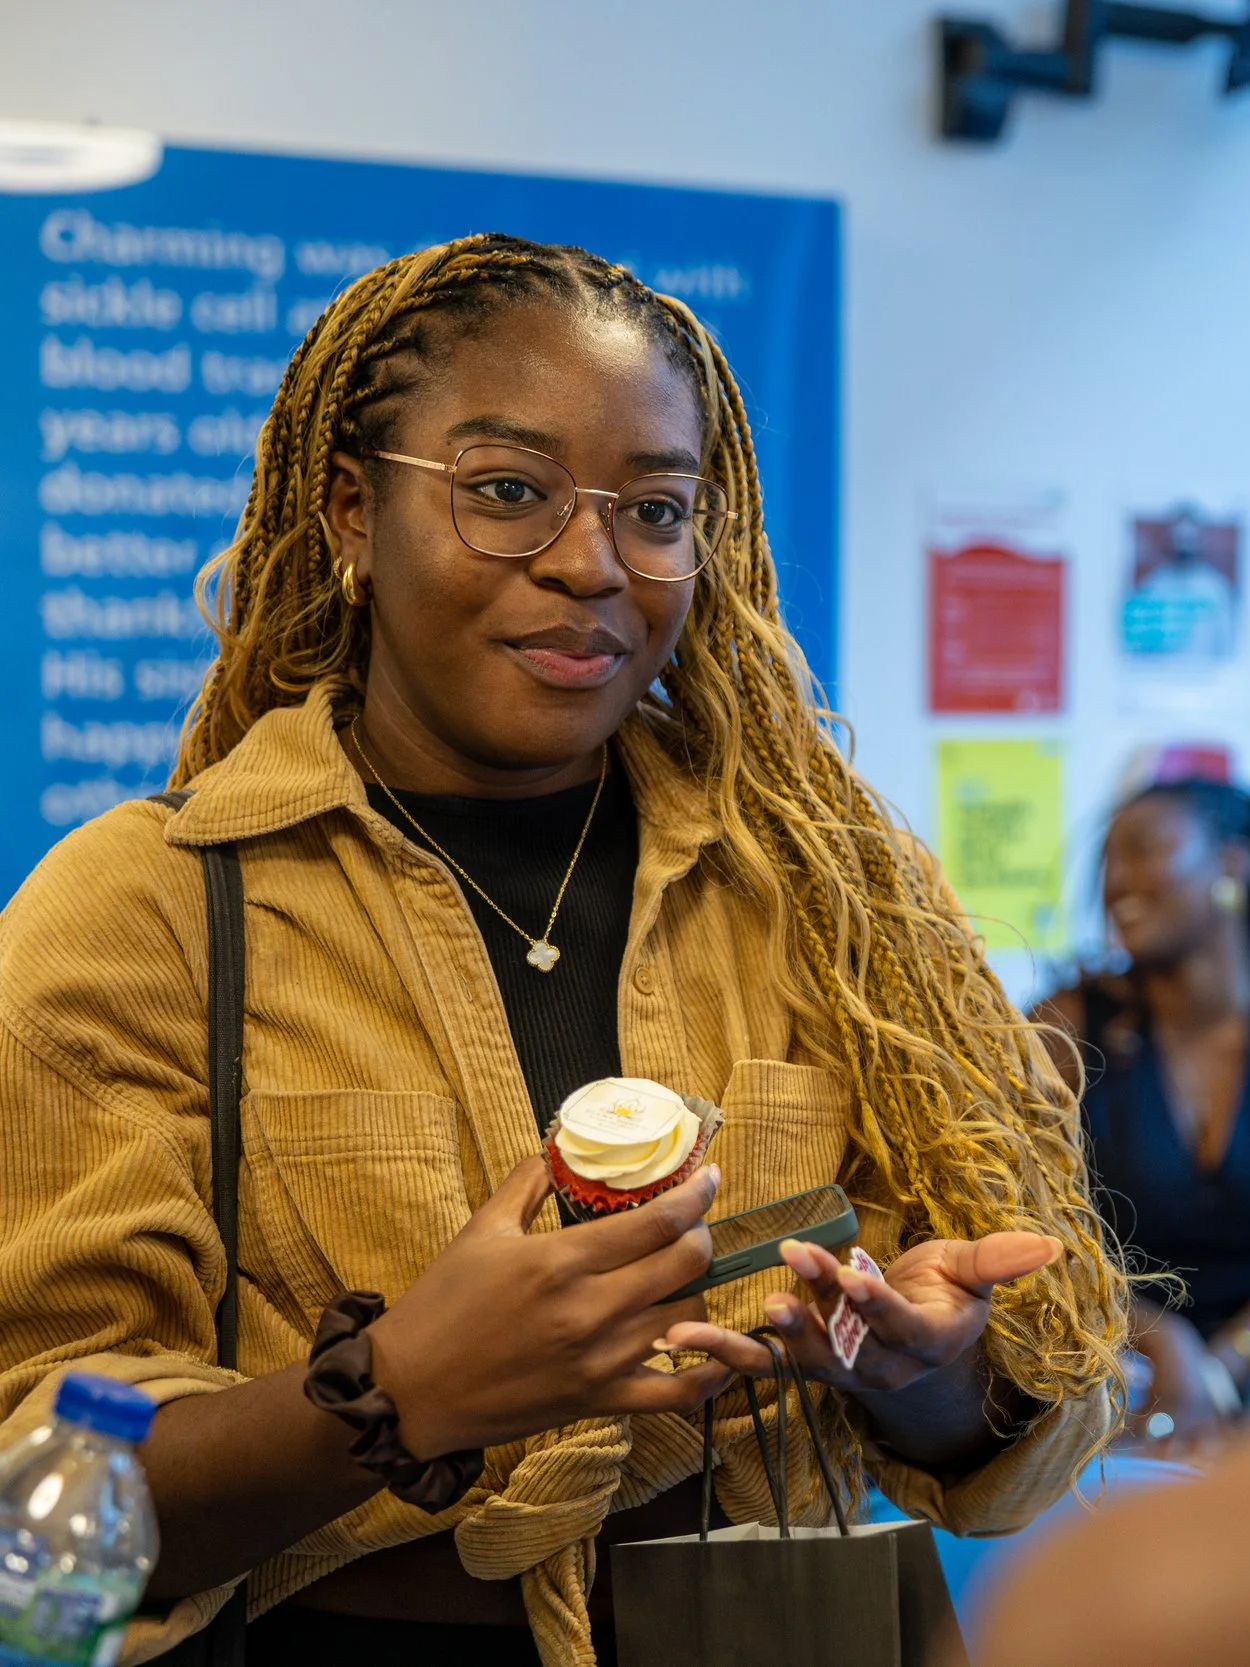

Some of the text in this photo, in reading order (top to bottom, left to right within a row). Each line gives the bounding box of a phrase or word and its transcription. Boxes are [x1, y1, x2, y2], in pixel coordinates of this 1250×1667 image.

[42, 209, 284, 280] Charming
[41, 276, 181, 330] sickle
[192, 287, 276, 332] cell
[41, 335, 283, 394] blood tra
[41, 409, 180, 460] years
[42, 522, 195, 577] better
[42, 650, 123, 698] His
